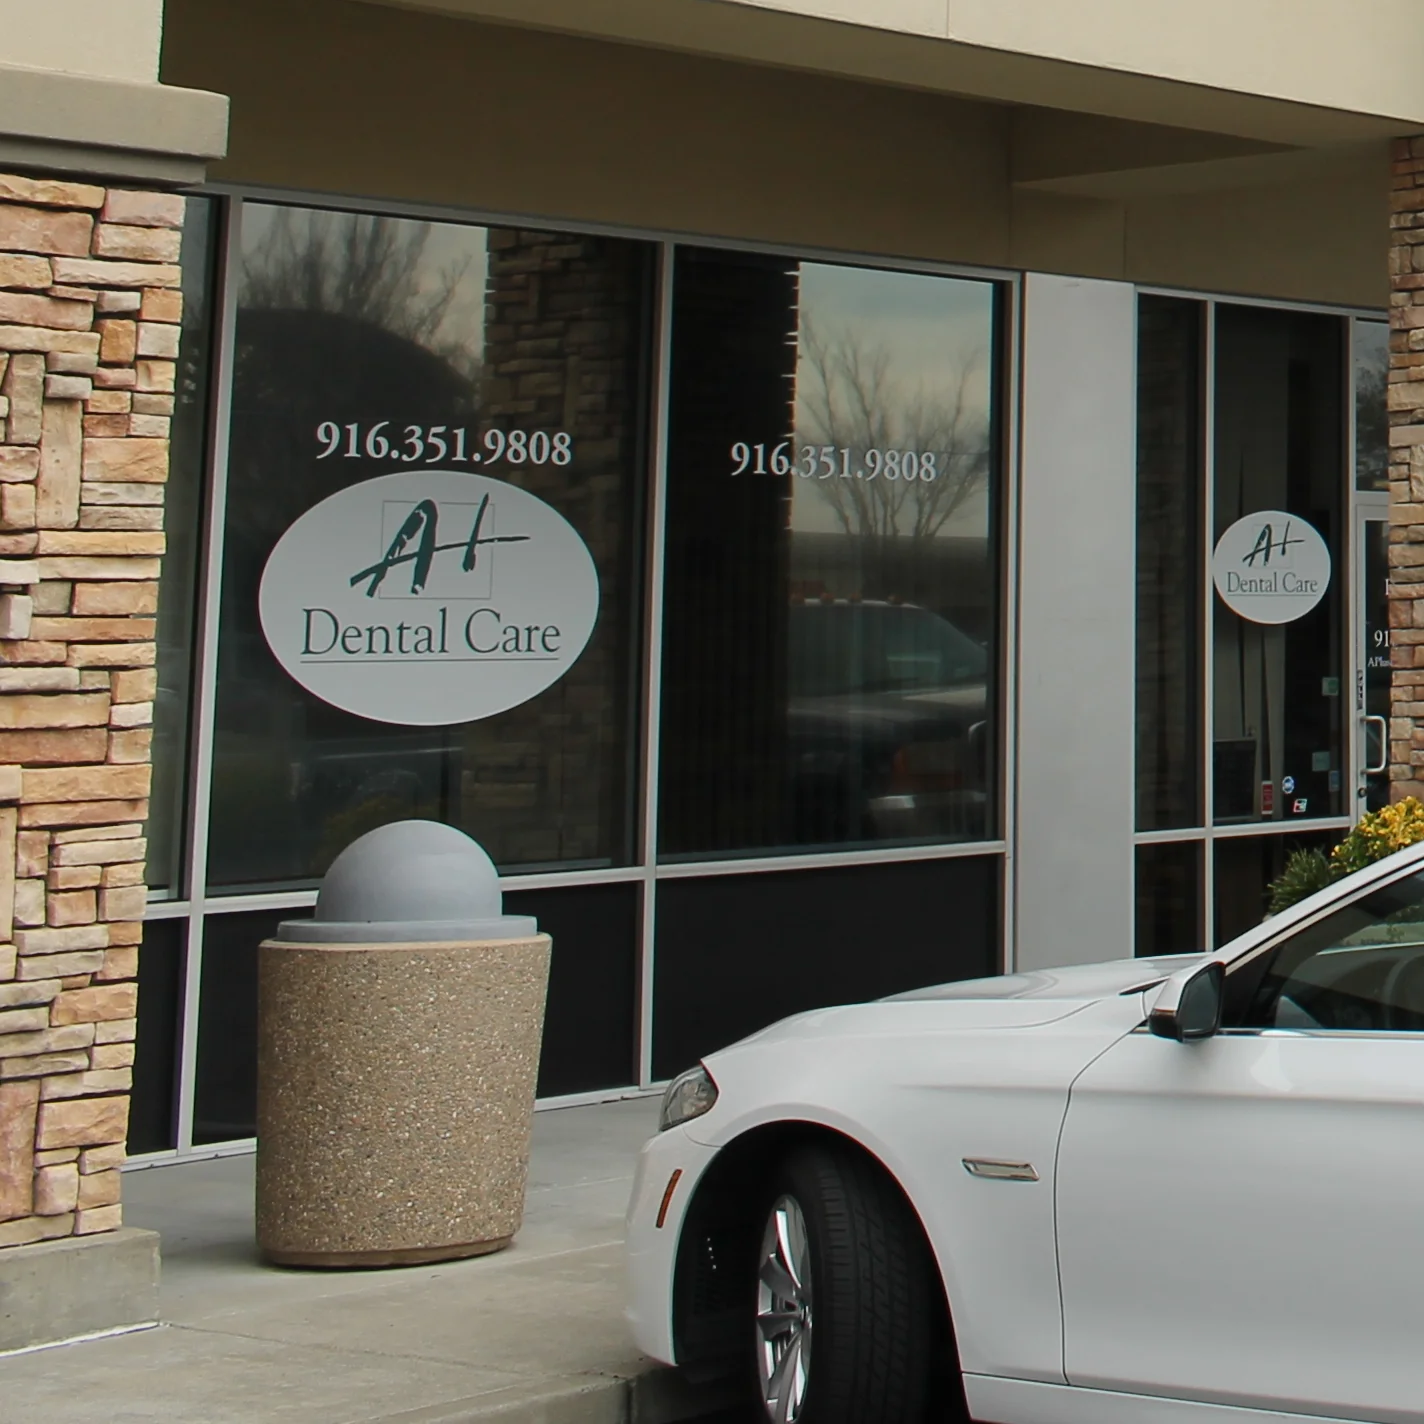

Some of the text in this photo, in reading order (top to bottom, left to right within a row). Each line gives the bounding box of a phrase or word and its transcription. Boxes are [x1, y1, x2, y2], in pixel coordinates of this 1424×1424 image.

[316, 421, 572, 466] 916.351.9808
[730, 441, 937, 482] 916.351.9808
[1227, 571, 1319, 593] Dental Care
[301, 606, 561, 656] Dental Care
